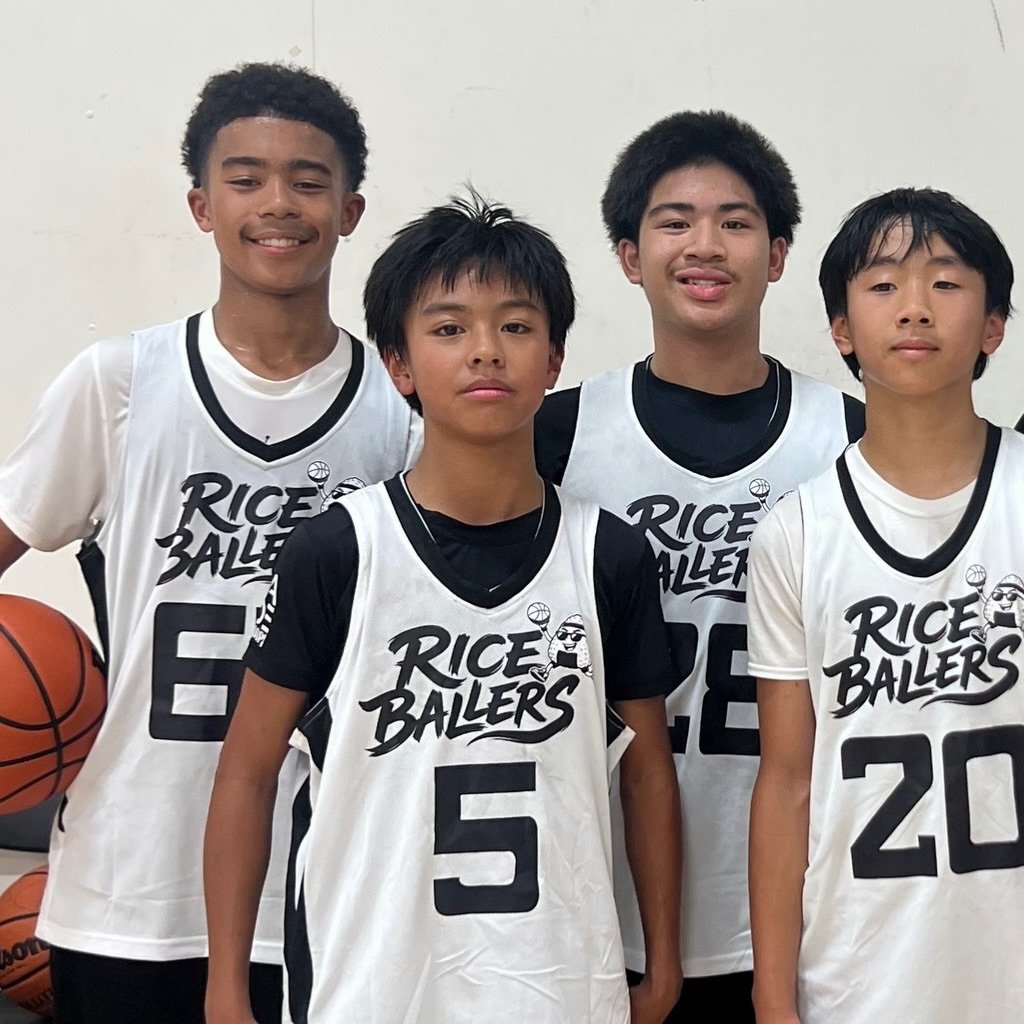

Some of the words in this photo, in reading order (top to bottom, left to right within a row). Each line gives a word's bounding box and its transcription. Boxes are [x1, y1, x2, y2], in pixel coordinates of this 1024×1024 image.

[181, 472, 318, 533] RICE
[626, 494, 761, 550] RICE
[155, 526, 286, 586] BALLE
[843, 594, 980, 655] RICE
[149, 602, 263, 741] 6
[387, 625, 541, 688] RICE
[823, 635, 1019, 719] BALLERS
[359, 676, 580, 757] BALLERS
[433, 762, 539, 916] 5
